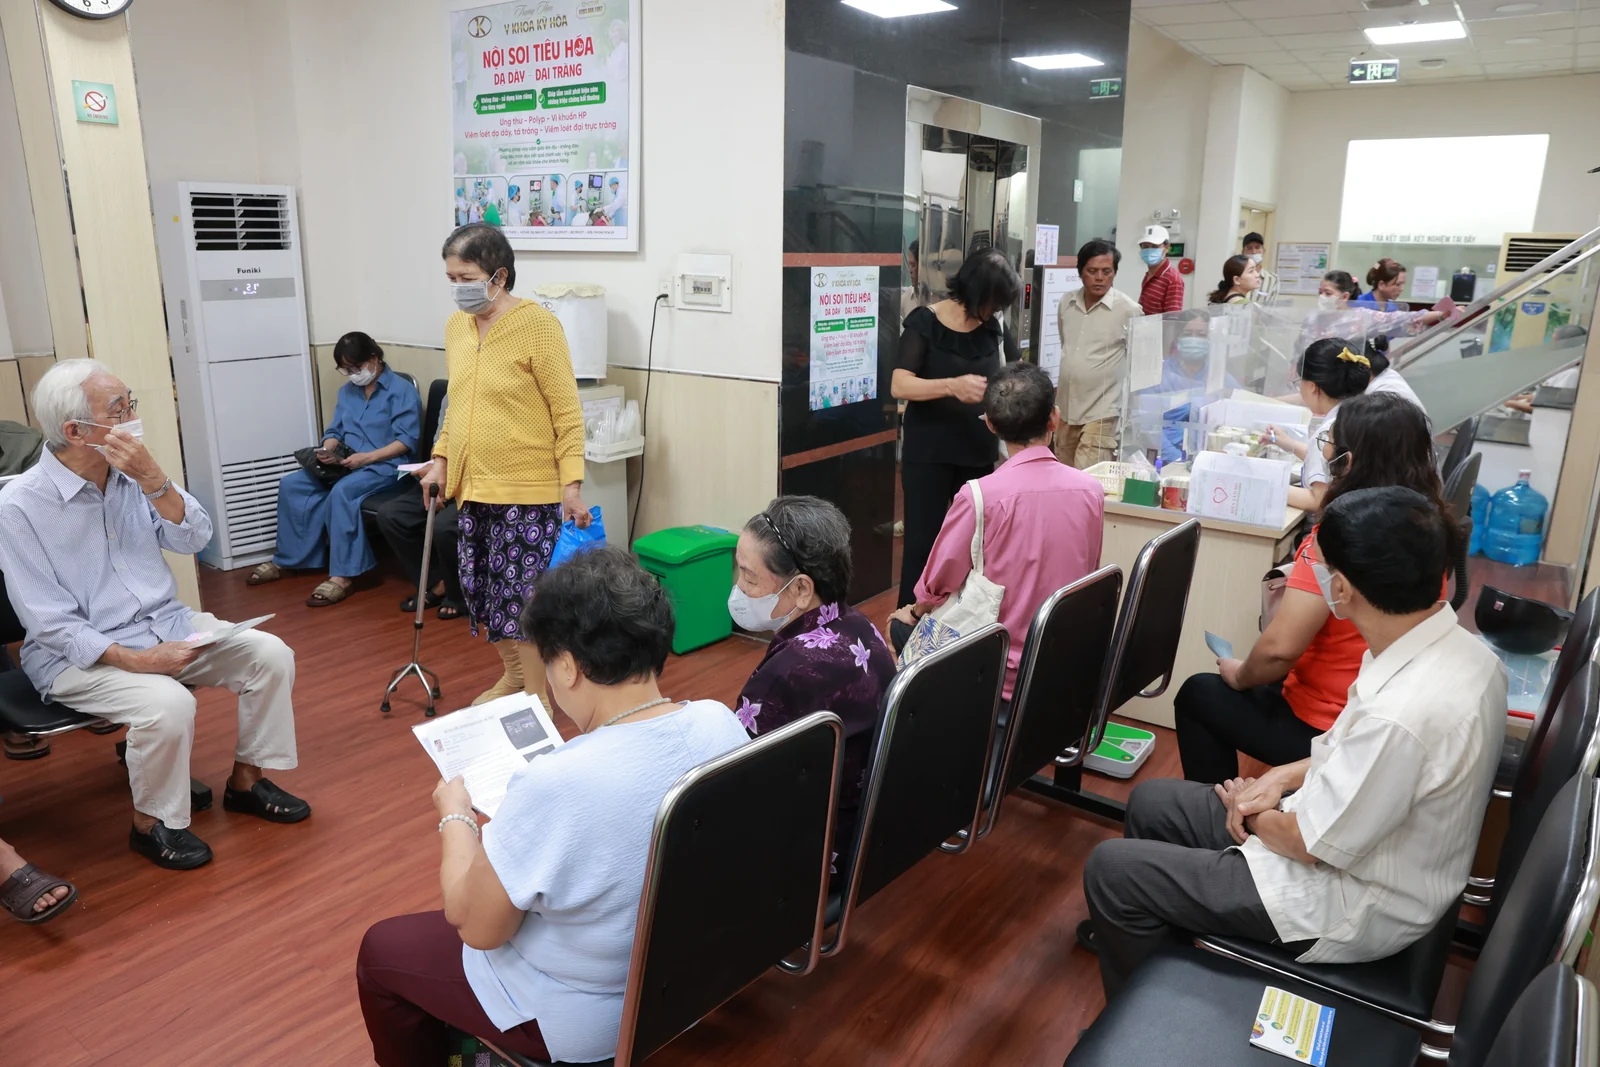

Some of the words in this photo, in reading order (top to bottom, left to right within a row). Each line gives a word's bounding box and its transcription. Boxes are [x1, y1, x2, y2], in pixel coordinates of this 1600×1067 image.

[504, 24, 510, 36] Y
[512, 20, 534, 34] KHOA
[483, 46, 504, 69] NỘI
[508, 46, 529, 65] SOI
[533, 38, 560, 62] TIÊU
[565, 34, 594, 58] HÓA
[494, 73, 506, 86] DẠ
[508, 68, 525, 84] DÀY
[535, 68, 550, 82] ĐẠI
[552, 63, 582, 79] TRÀNG
[529, 115, 545, 124] Polyp
[578, 111, 587, 119] HP
[573, 123, 583, 132] đại
[585, 122, 597, 131] trực
[599, 121, 616, 129] tràng
[820, 292, 831, 306] NỘI
[833, 293, 843, 304] SOI
[845, 291, 857, 304] TIÊU
